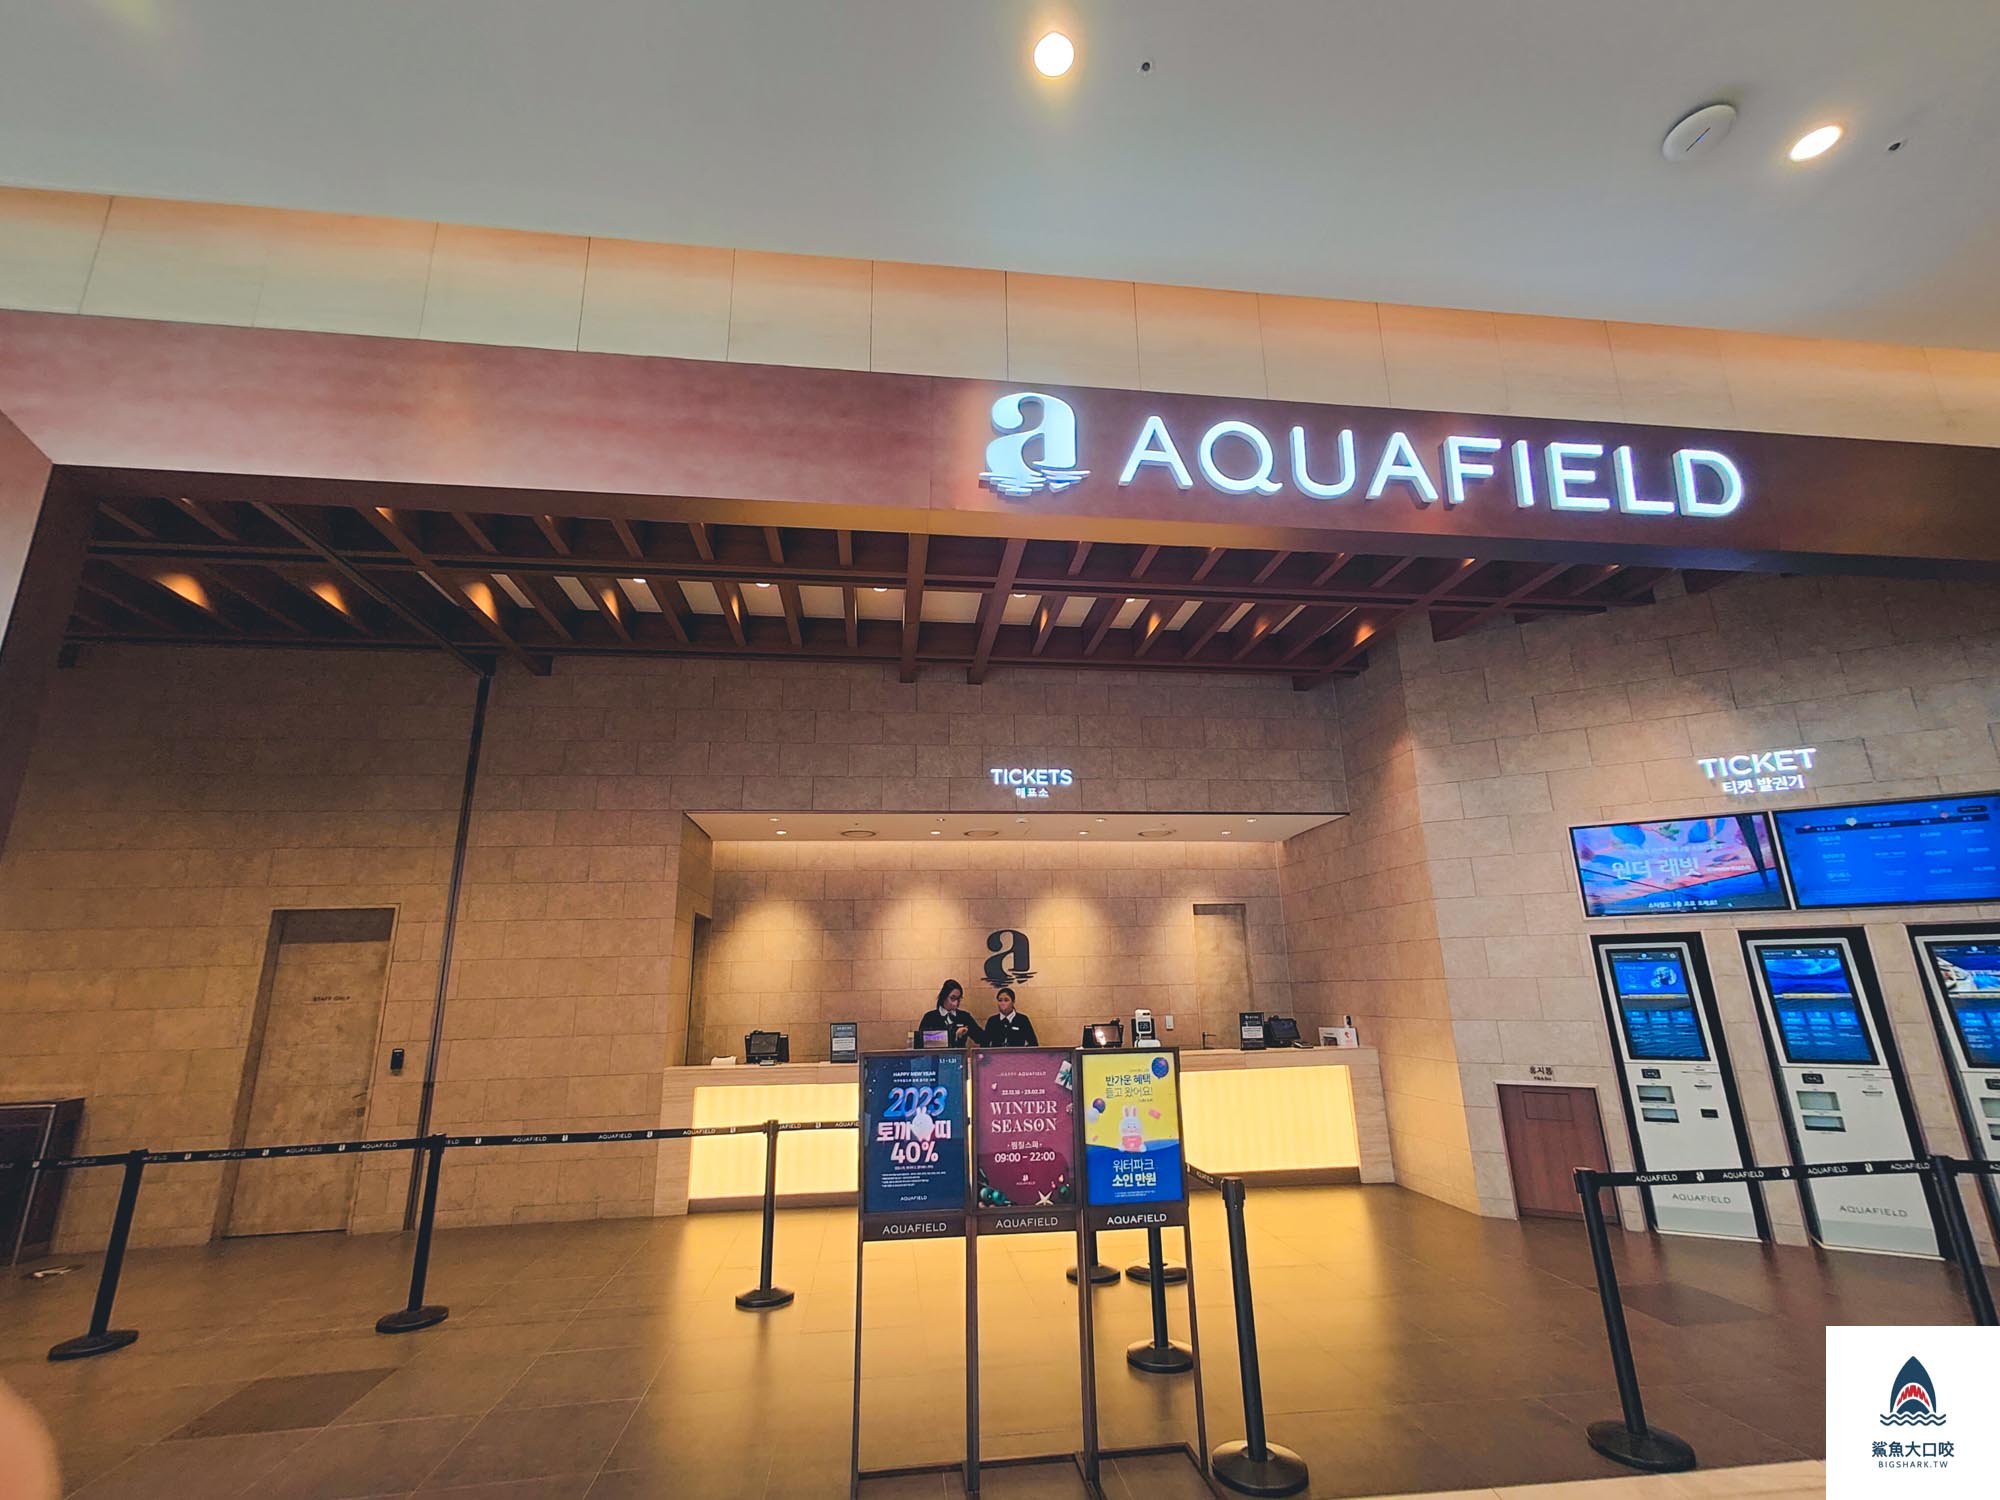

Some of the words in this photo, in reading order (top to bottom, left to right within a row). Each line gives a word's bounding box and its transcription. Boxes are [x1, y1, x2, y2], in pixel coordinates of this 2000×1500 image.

[1117, 414, 1745, 518] AQUAFIELD
[1697, 747, 1817, 779] TICKET
[990, 768, 1073, 786] TICKETS
[1721, 778, 1756, 795] 티켓
[1756, 774, 1806, 793] 발권기
[1611, 858, 1652, 880] 원더
[1659, 856, 1701, 878] 래빗
[1105, 1074, 1132, 1087] 반가운
[1133, 1073, 1151, 1085] 혜택
[1105, 1087, 1122, 1099] 들고
[1124, 1086, 1153, 1098] 왔어요!
[883, 1086, 948, 1118] 2023
[990, 1100, 1058, 1116] WINTER
[778, 1122, 802, 1130] UAFIELD
[991, 1117, 1057, 1133] SEASON
[511, 1135, 548, 1143] AQUAFIELD
[598, 1132, 633, 1140] AQUAFIELD
[682, 1128, 717, 1136] AQUAFIELD
[285, 1146, 323, 1154] AQUAFIELD
[361, 1141, 398, 1150] AQUAFIELD
[890, 1141, 940, 1164] 40%
[994, 1153, 1021, 1163] 09:00
[1029, 1151, 1056, 1162] 22:00
[1112, 1158, 1155, 1173] 워터파크
[1635, 1173, 1678, 1183] AQUAFIELD
[1722, 1169, 1765, 1180] AQUAFIELD
[1807, 1165, 1849, 1176] AQUAFIELD
[1890, 1161, 1931, 1170] AQUAFIELD
[1112, 1174, 1134, 1188] 소인
[1134, 1172, 1157, 1187] 만원
[1672, 1193, 1732, 1205] AQUAFIELD
[1107, 1213, 1167, 1225] AQUAFIELD
[1839, 1205, 1908, 1218] AQUAFIELD
[882, 1222, 947, 1235] AQUAFIELD
[995, 1216, 1059, 1229] AQUAFIELD
